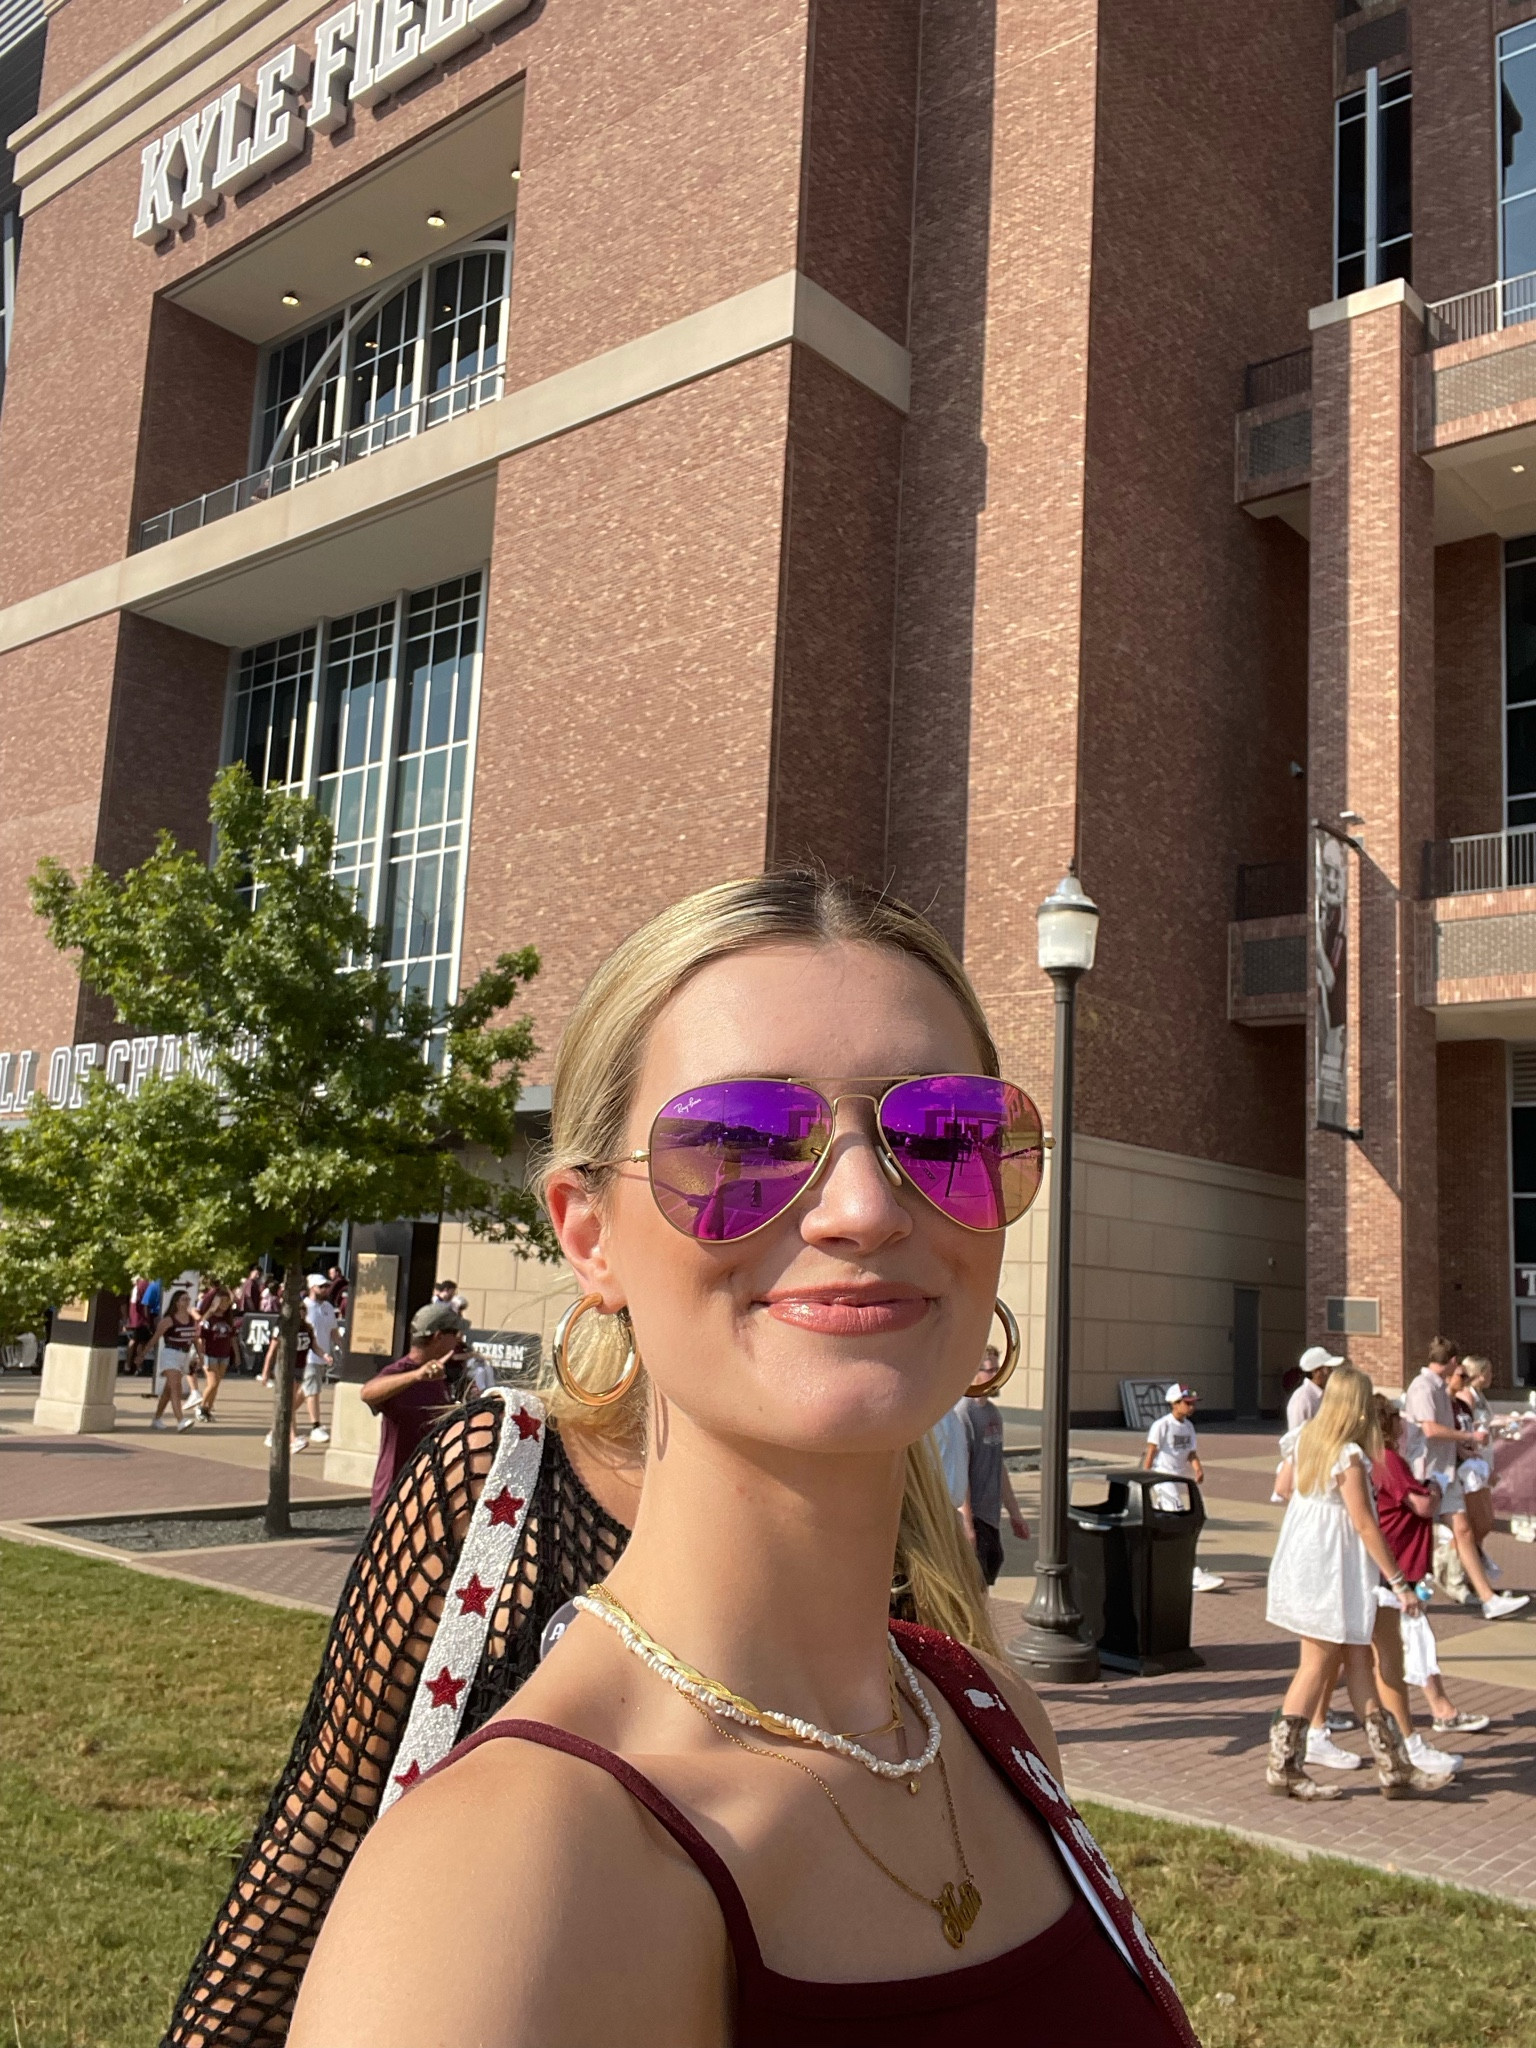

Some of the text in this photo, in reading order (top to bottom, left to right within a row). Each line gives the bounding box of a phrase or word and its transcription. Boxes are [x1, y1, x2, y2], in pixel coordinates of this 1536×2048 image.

[133, 0, 504, 239] KYLE FIEL
[47, 1043, 97, 1109] OF
[472, 1342, 505, 1360] TEXAS
